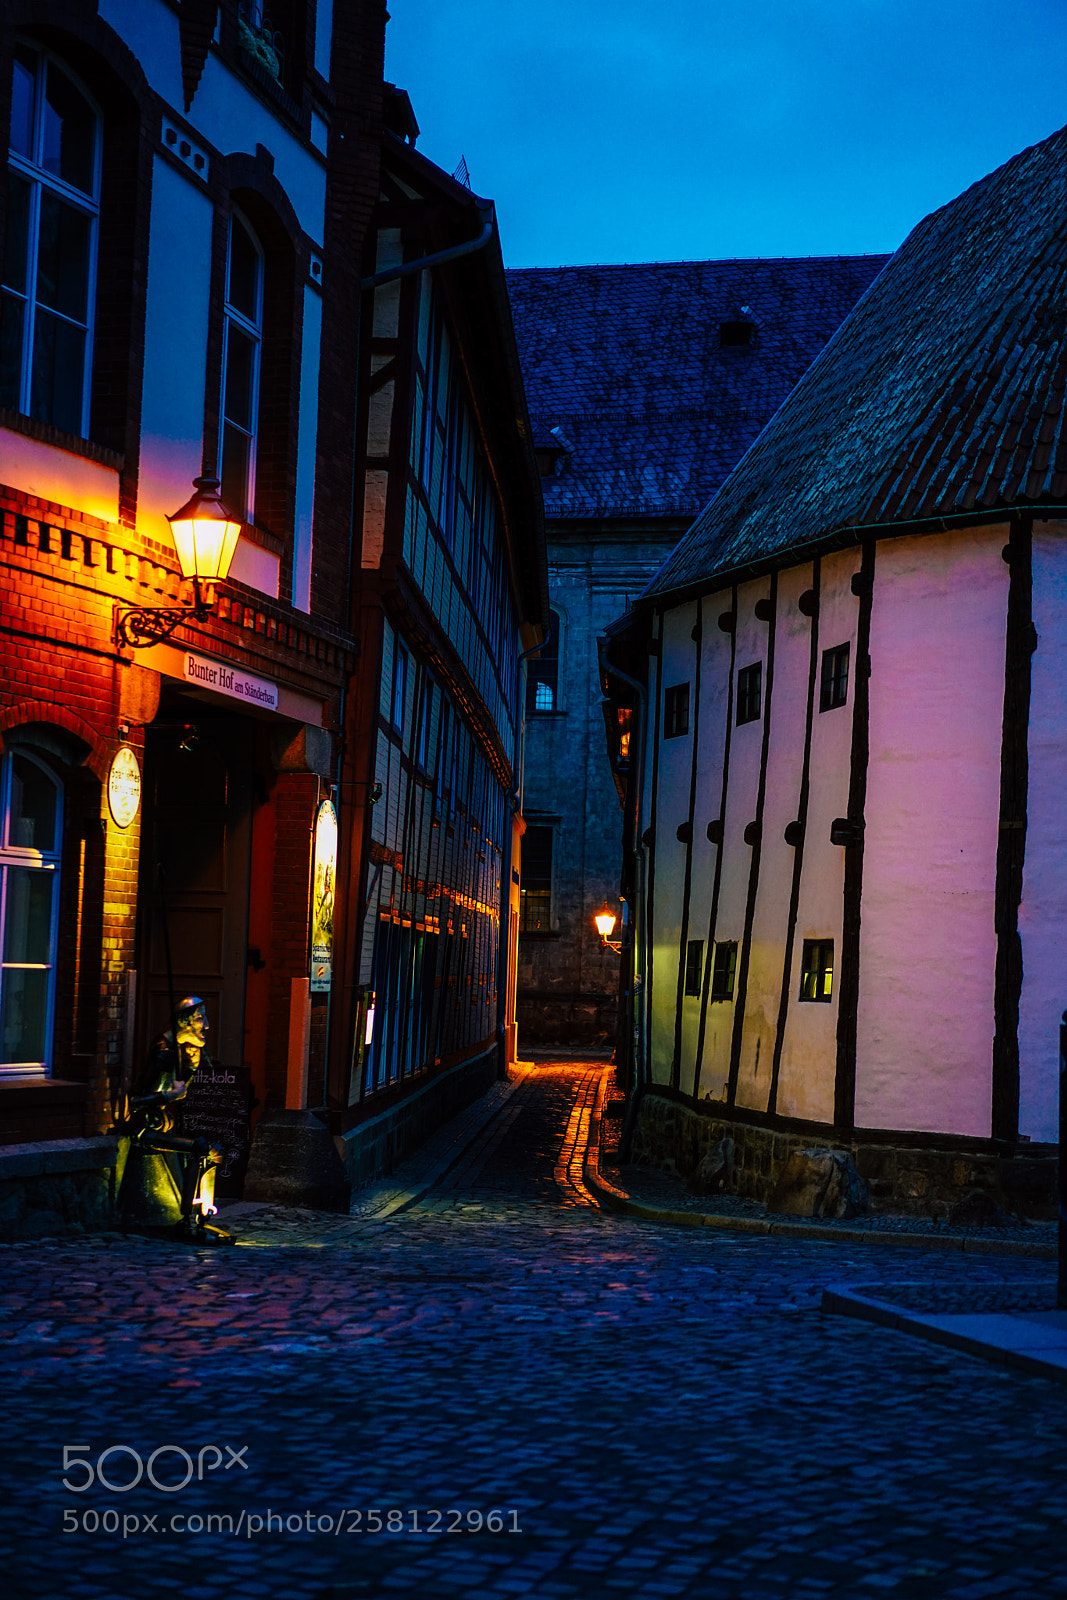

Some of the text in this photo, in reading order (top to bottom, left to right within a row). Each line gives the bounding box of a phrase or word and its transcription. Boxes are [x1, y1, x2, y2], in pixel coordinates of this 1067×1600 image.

[188, 656, 275, 705] Bunter Hof am Ständerbau
[193, 1069, 236, 1084] ritz-kola
